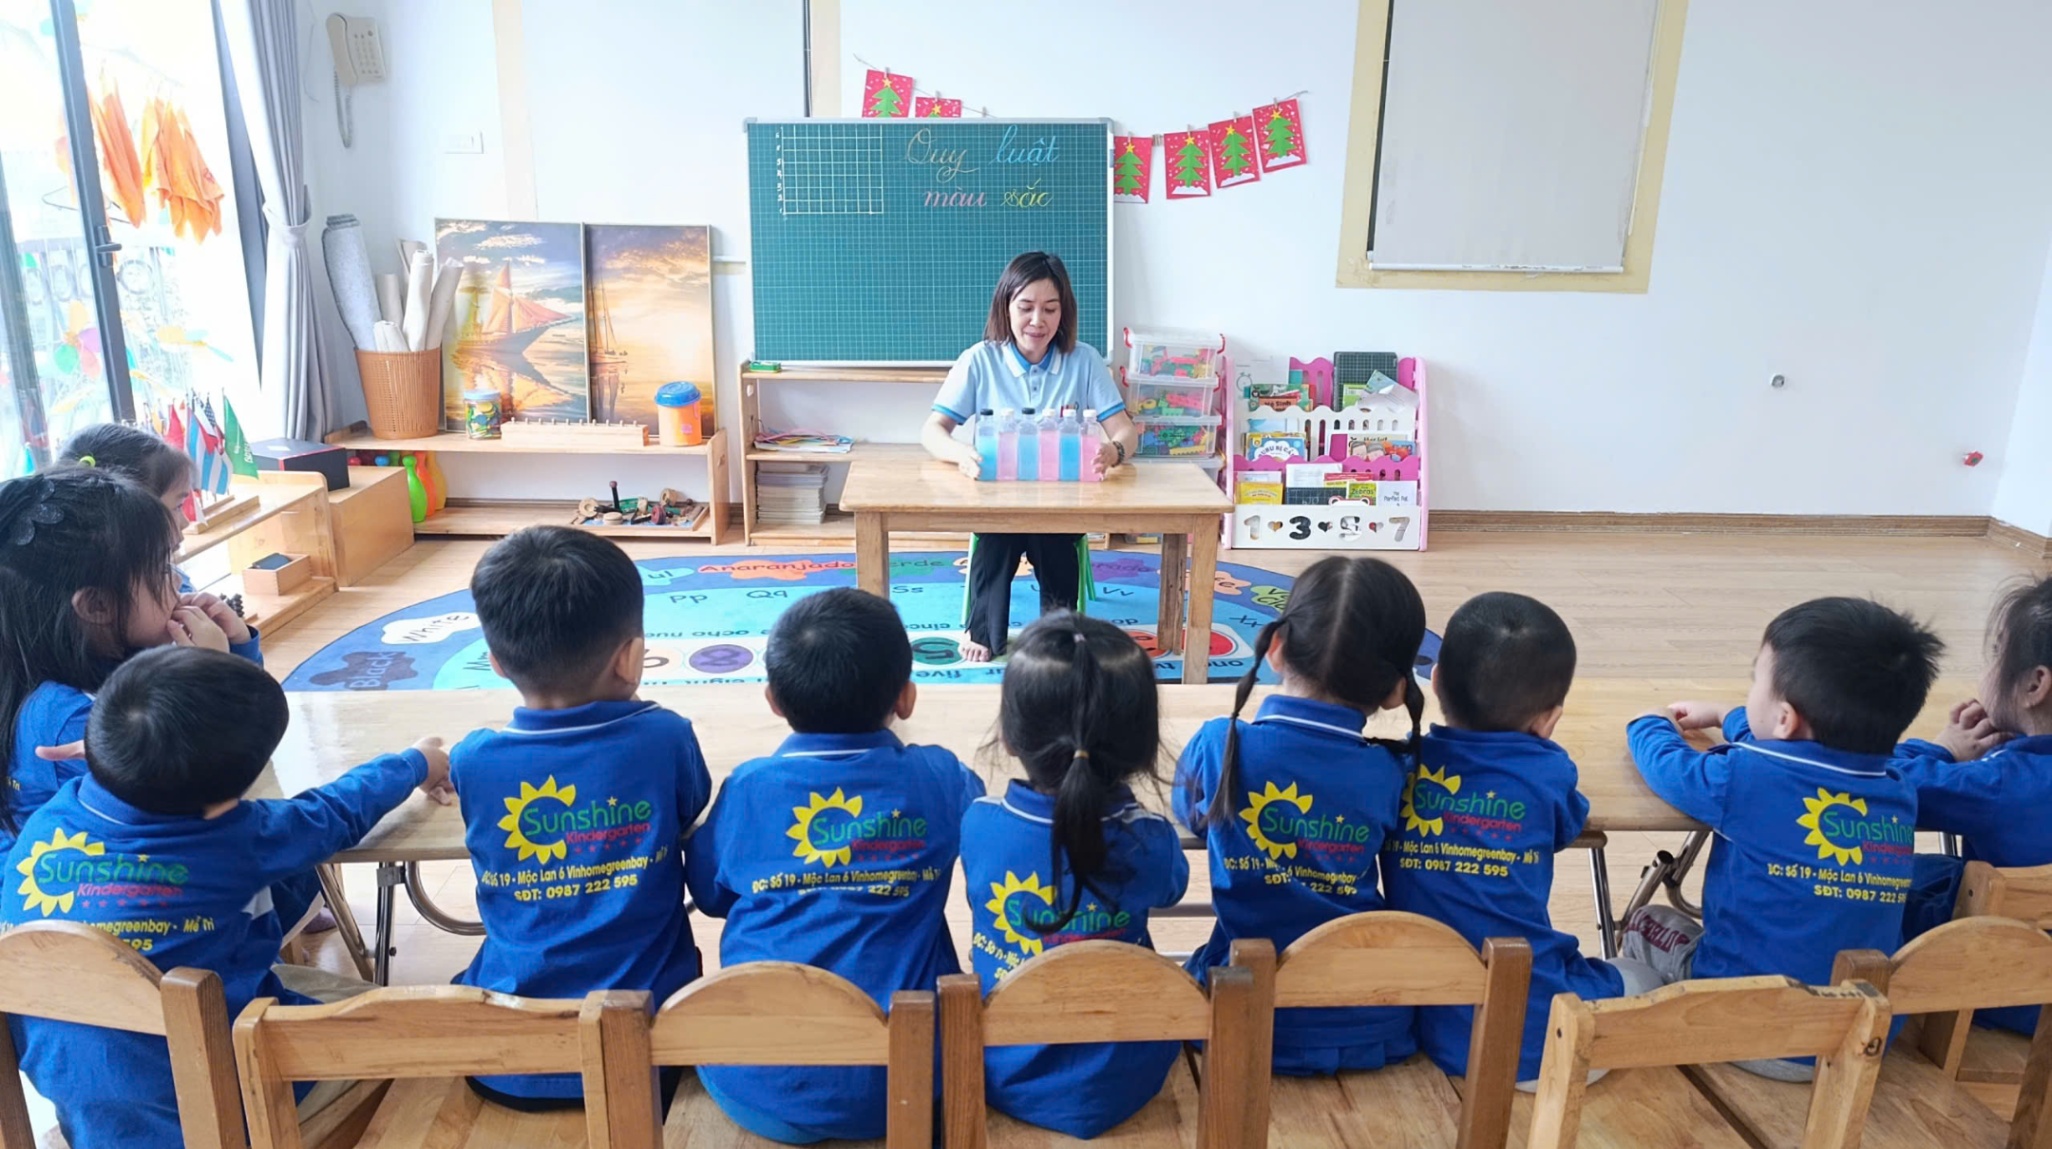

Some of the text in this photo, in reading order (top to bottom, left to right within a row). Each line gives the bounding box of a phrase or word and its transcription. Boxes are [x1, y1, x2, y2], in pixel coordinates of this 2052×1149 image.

[907, 124, 1059, 183] Quy luật
[924, 177, 1054, 208] màu sắc
[1244, 515, 1261, 540] 1
[1289, 515, 1311, 540] 3
[1388, 516, 1411, 542] 7
[700, 560, 855, 575] Anaranjado
[889, 559, 943, 567] erde
[670, 594, 708, 604] Pp
[746, 589, 788, 599] Qq
[401, 615, 470, 642] White
[700, 648, 742, 667] 8
[913, 641, 954, 660] 5
[350, 651, 400, 689] Black
[916, 669, 962, 679] five
[1414, 783, 1526, 820] Sunshine
[523, 799, 652, 836] Sunshine
[1262, 807, 1370, 842] Sunshine
[1443, 812, 1522, 832] Kindergarten
[1823, 811, 1913, 843] Sunshine
[566, 822, 651, 844] Kindergarten
[812, 811, 927, 845] Sunshine
[851, 839, 926, 853] Kindergarten
[1297, 838, 1364, 854] Kindergarten
[1403, 841, 1418, 856] Mộc
[1420, 842, 1434, 854] Lan
[1440, 842, 1516, 864] Vinhomegreenbay
[38, 854, 189, 884] Sunshine
[499, 872, 511, 887] 19
[518, 871, 538, 886] Mộc
[540, 869, 557, 882] Lan
[559, 868, 566, 880] 6
[566, 855, 648, 879] Vinhomegreenbay
[1239, 855, 1249, 870] Số
[1400, 857, 1508, 877] SĐT: 0987 222 595
[752, 879, 769, 895] ĐC:
[770, 871, 783, 889] Số
[784, 873, 796, 887] 19
[803, 872, 823, 889] Mộc
[824, 872, 841, 883] Lan
[843, 870, 849, 882] 6
[1264, 873, 1291, 885] SĐT:
[1785, 863, 1798, 878] Số
[1800, 866, 1812, 878] 19
[1818, 869, 1839, 884] Mộc
[1840, 870, 1856, 882] Lan
[1858, 873, 1864, 884] 6
[77, 882, 183, 898] Kindergarten
[514, 874, 638, 902] SĐT: 0987 222 595
[868, 885, 891, 896] 222
[1310, 882, 1332, 894] 222
[1814, 884, 1843, 898] SĐT:
[1846, 888, 1877, 901] 0987
[1879, 891, 1896, 903] 222
